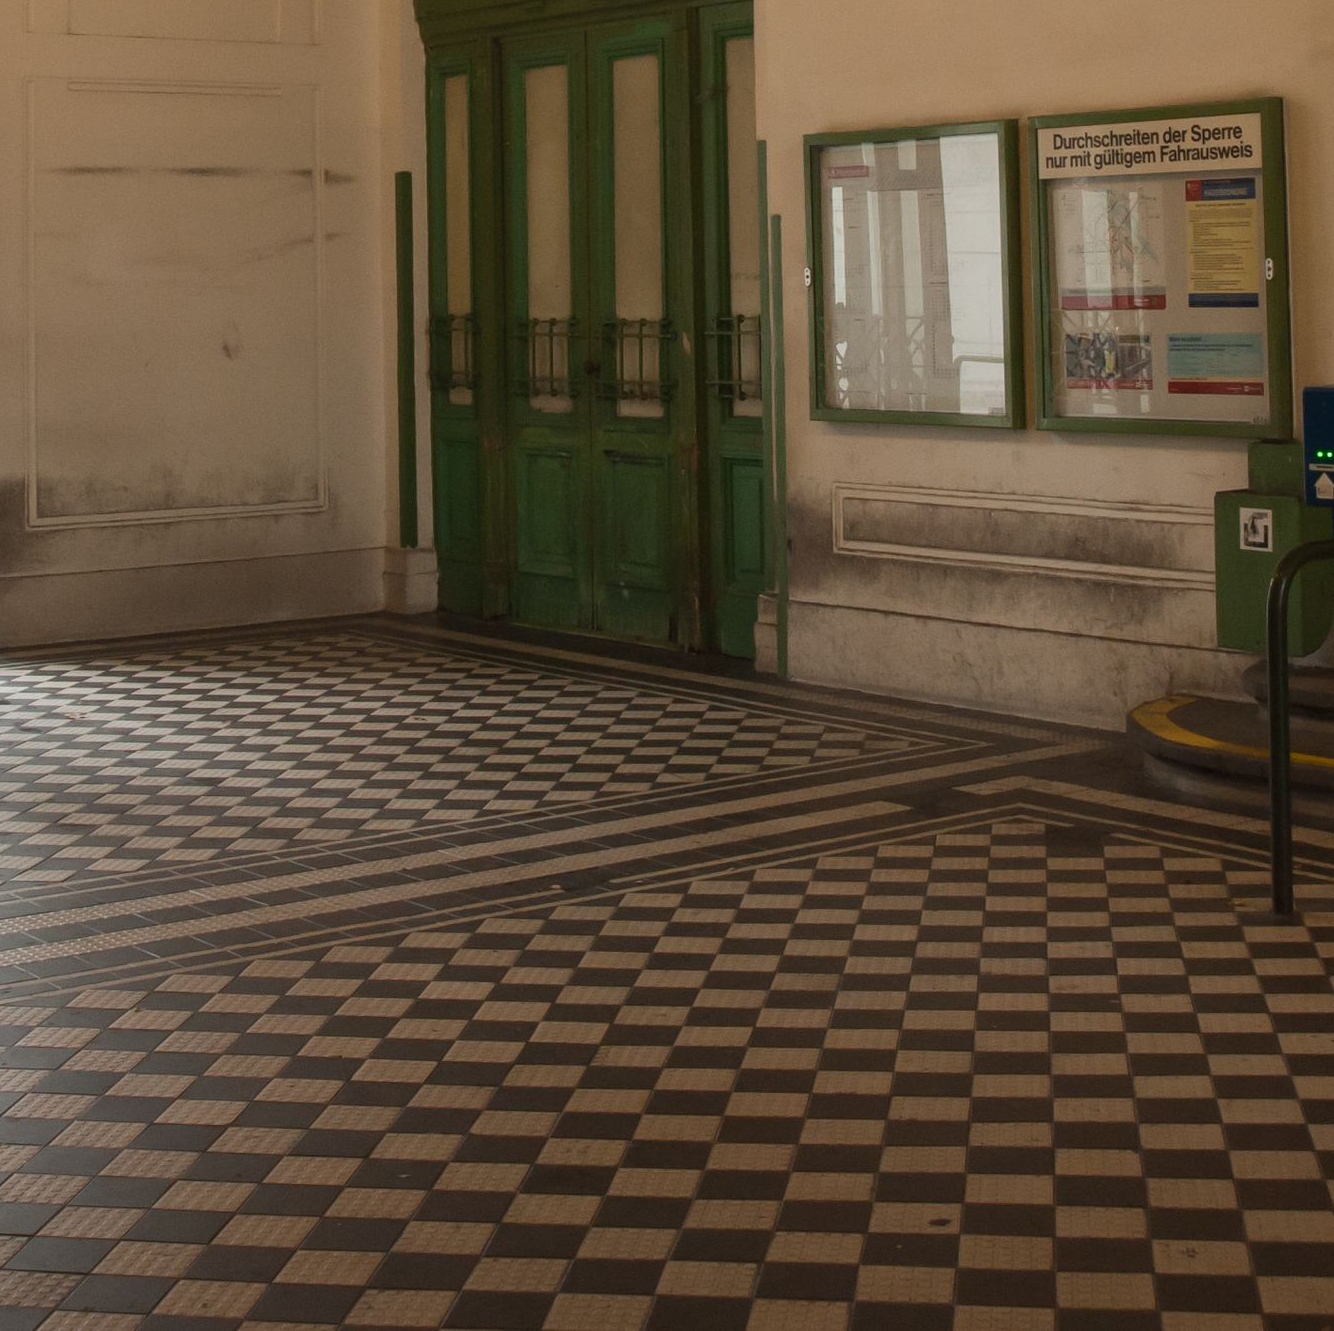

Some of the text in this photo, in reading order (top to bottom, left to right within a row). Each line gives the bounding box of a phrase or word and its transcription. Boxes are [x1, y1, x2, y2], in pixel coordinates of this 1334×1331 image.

[1053, 124, 1243, 150] Durchschreiten der Sperre
[1046, 141, 1253, 169] nur mit gültigem Fahrausweis
